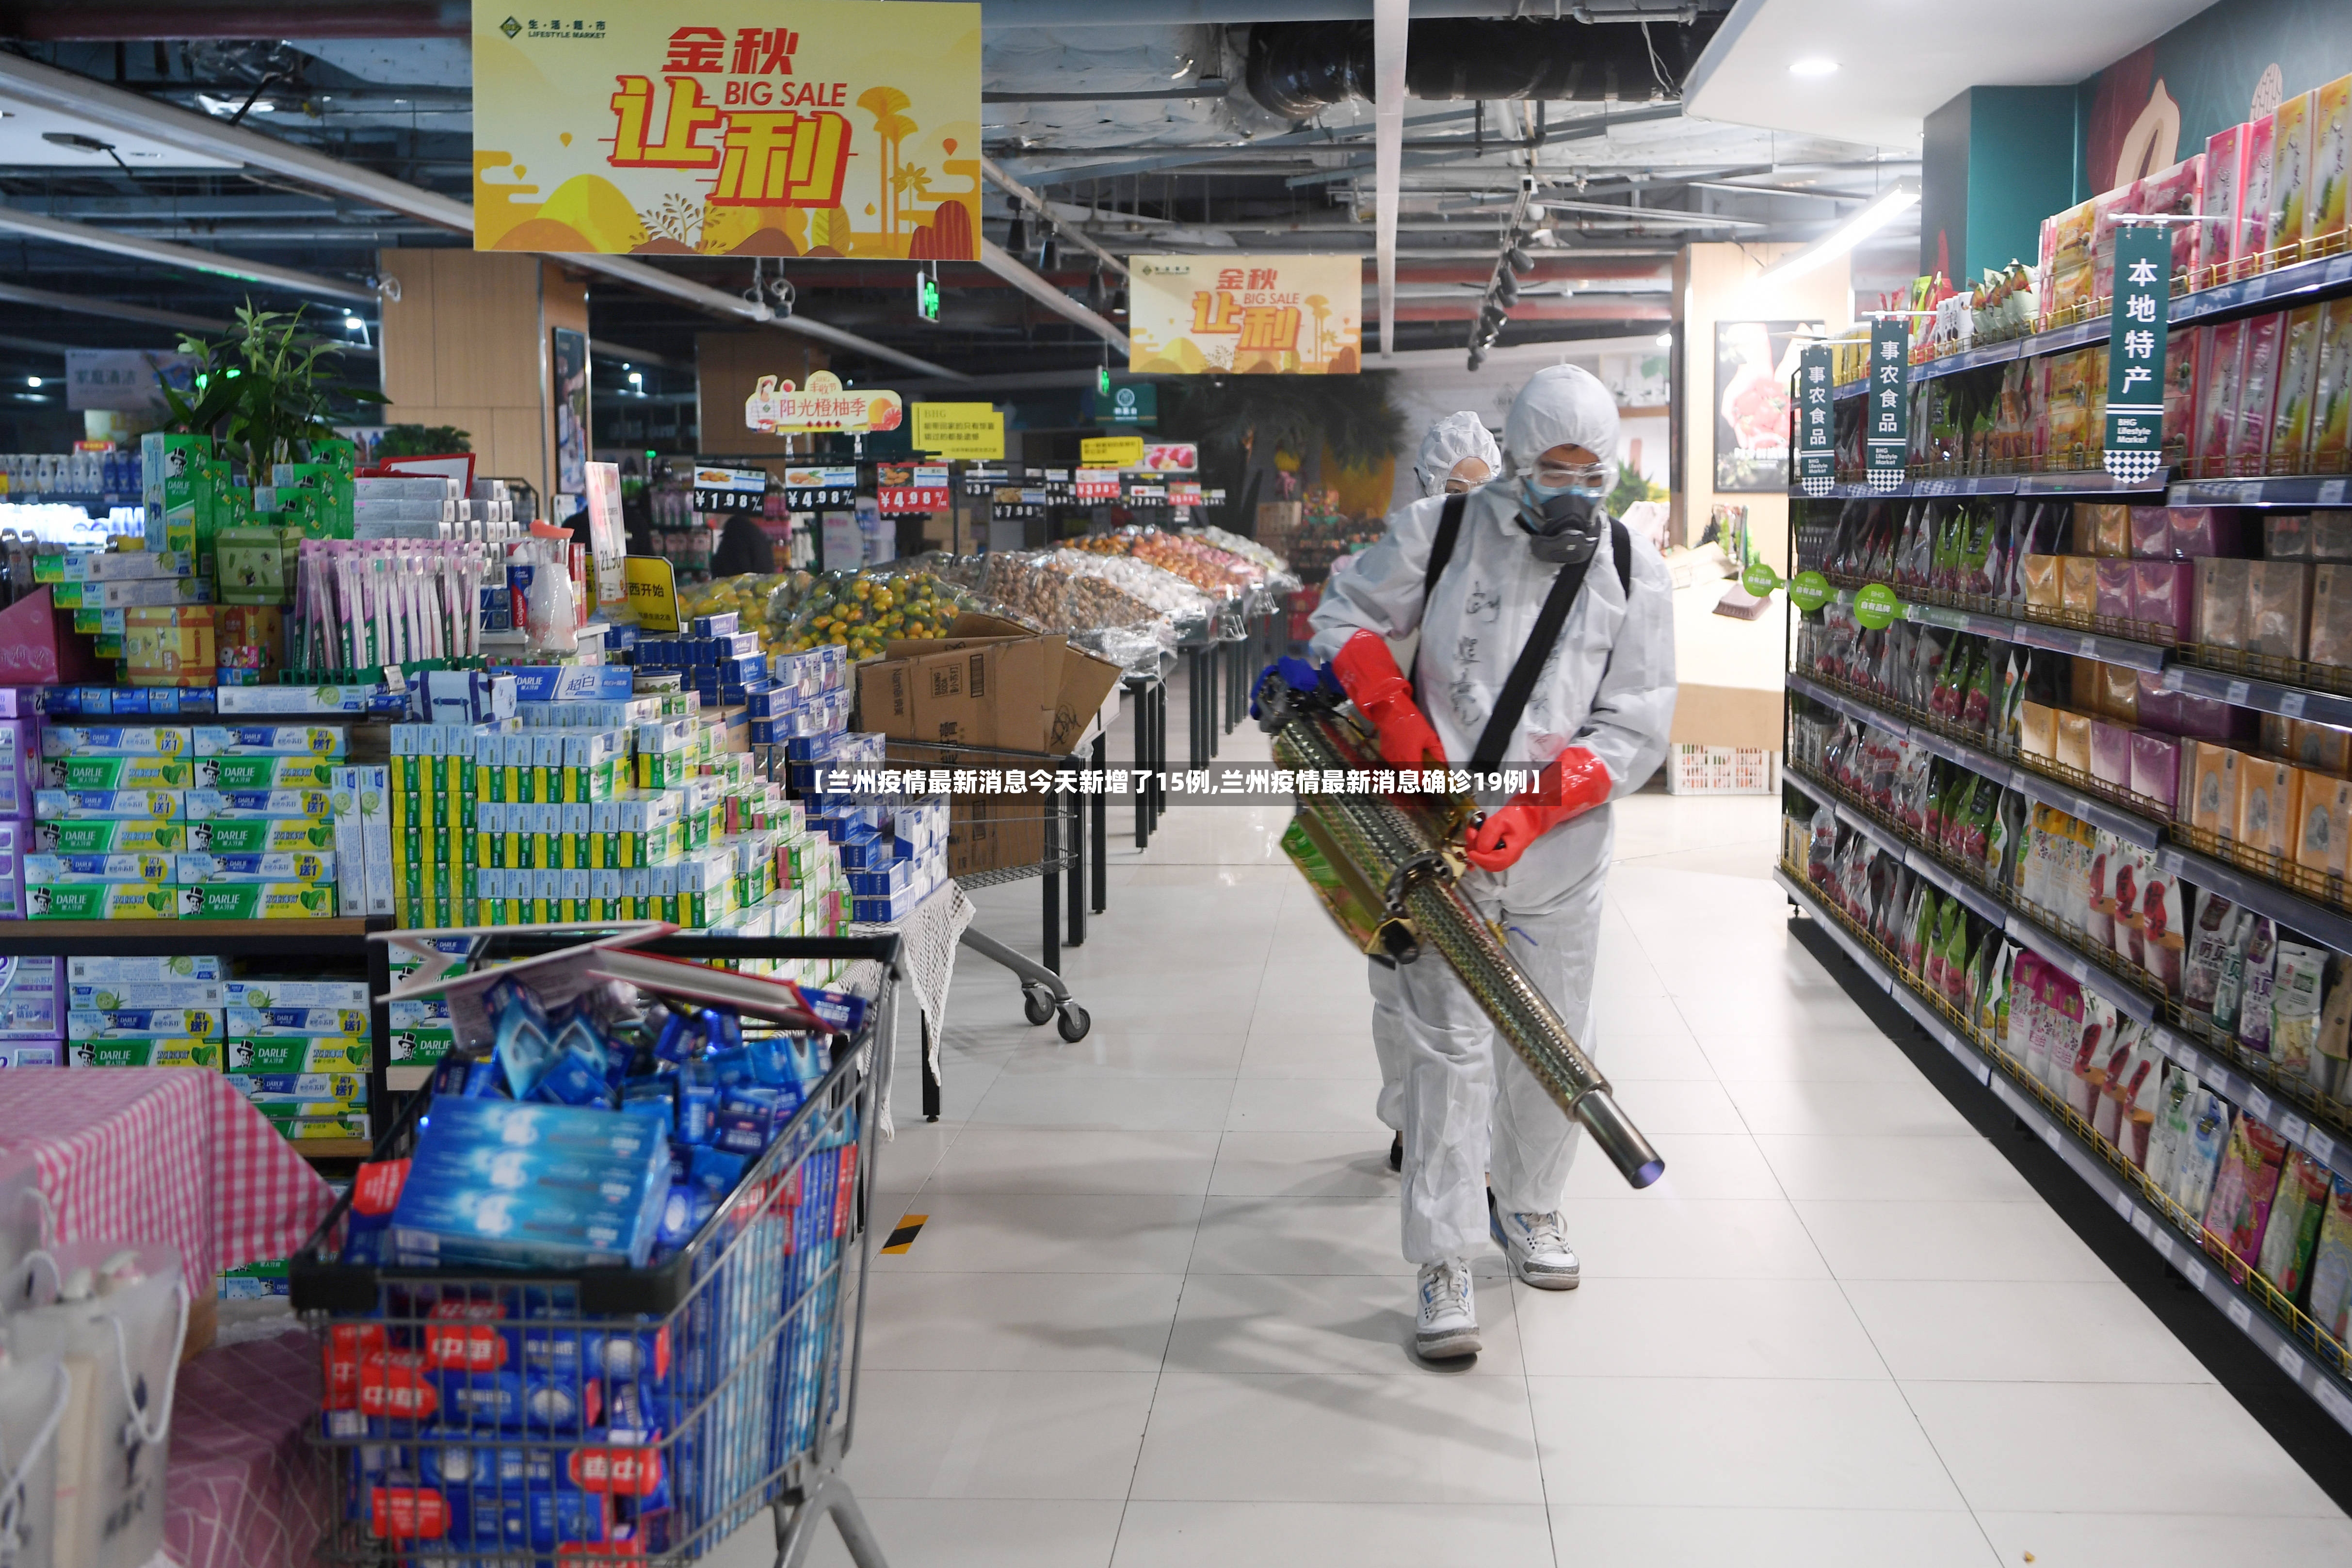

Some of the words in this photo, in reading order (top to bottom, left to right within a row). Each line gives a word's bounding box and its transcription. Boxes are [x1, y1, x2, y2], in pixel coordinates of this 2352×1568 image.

[661, 26, 799, 76] 金秋
[725, 81, 774, 106] BIG
[779, 82, 848, 107] SALE
[606, 74, 853, 209] 让利
[1215, 267, 1279, 291] 金秋
[1243, 293, 1266, 305] BIG
[1269, 293, 1300, 305] SALE
[1191, 291, 1302, 351] 让利
[2121, 258, 2158, 394] 本地特产
[1878, 340, 1901, 433] 事农食品
[779, 398, 866, 418] 阳光橙柚季
[1808, 366, 1827, 446] 事农食品
[2117, 418, 2138, 426] BHG
[2117, 426, 2152, 436] Lifestyle
[2116, 435, 2148, 444] Market
[628, 582, 665, 598] 西开始
[1860, 600, 1891, 614] 自有品牌
[516, 676, 543, 685] DARLIE
[160, 739, 178, 751] 送1
[312, 739, 332, 750] 送1
[73, 767, 104, 777] DARLIE
[225, 767, 256, 776] DARLIE
[153, 802, 171, 814] 送1
[306, 801, 326, 813] 送1
[65, 830, 96, 841] DARLIE
[217, 830, 248, 841] DARLIE
[144, 866, 164, 877] 送1
[298, 864, 319, 877] 送1
[56, 894, 87, 905] DARLIE
[209, 893, 241, 904] DARLIE
[190, 1020, 210, 1033] 送1
[343, 1020, 362, 1032] 送1
[420, 1040, 451, 1050] DARLIE
[99, 1050, 131, 1060] DARLIE
[258, 1048, 289, 1058] DARLIE
[335, 1084, 355, 1097] 送1
